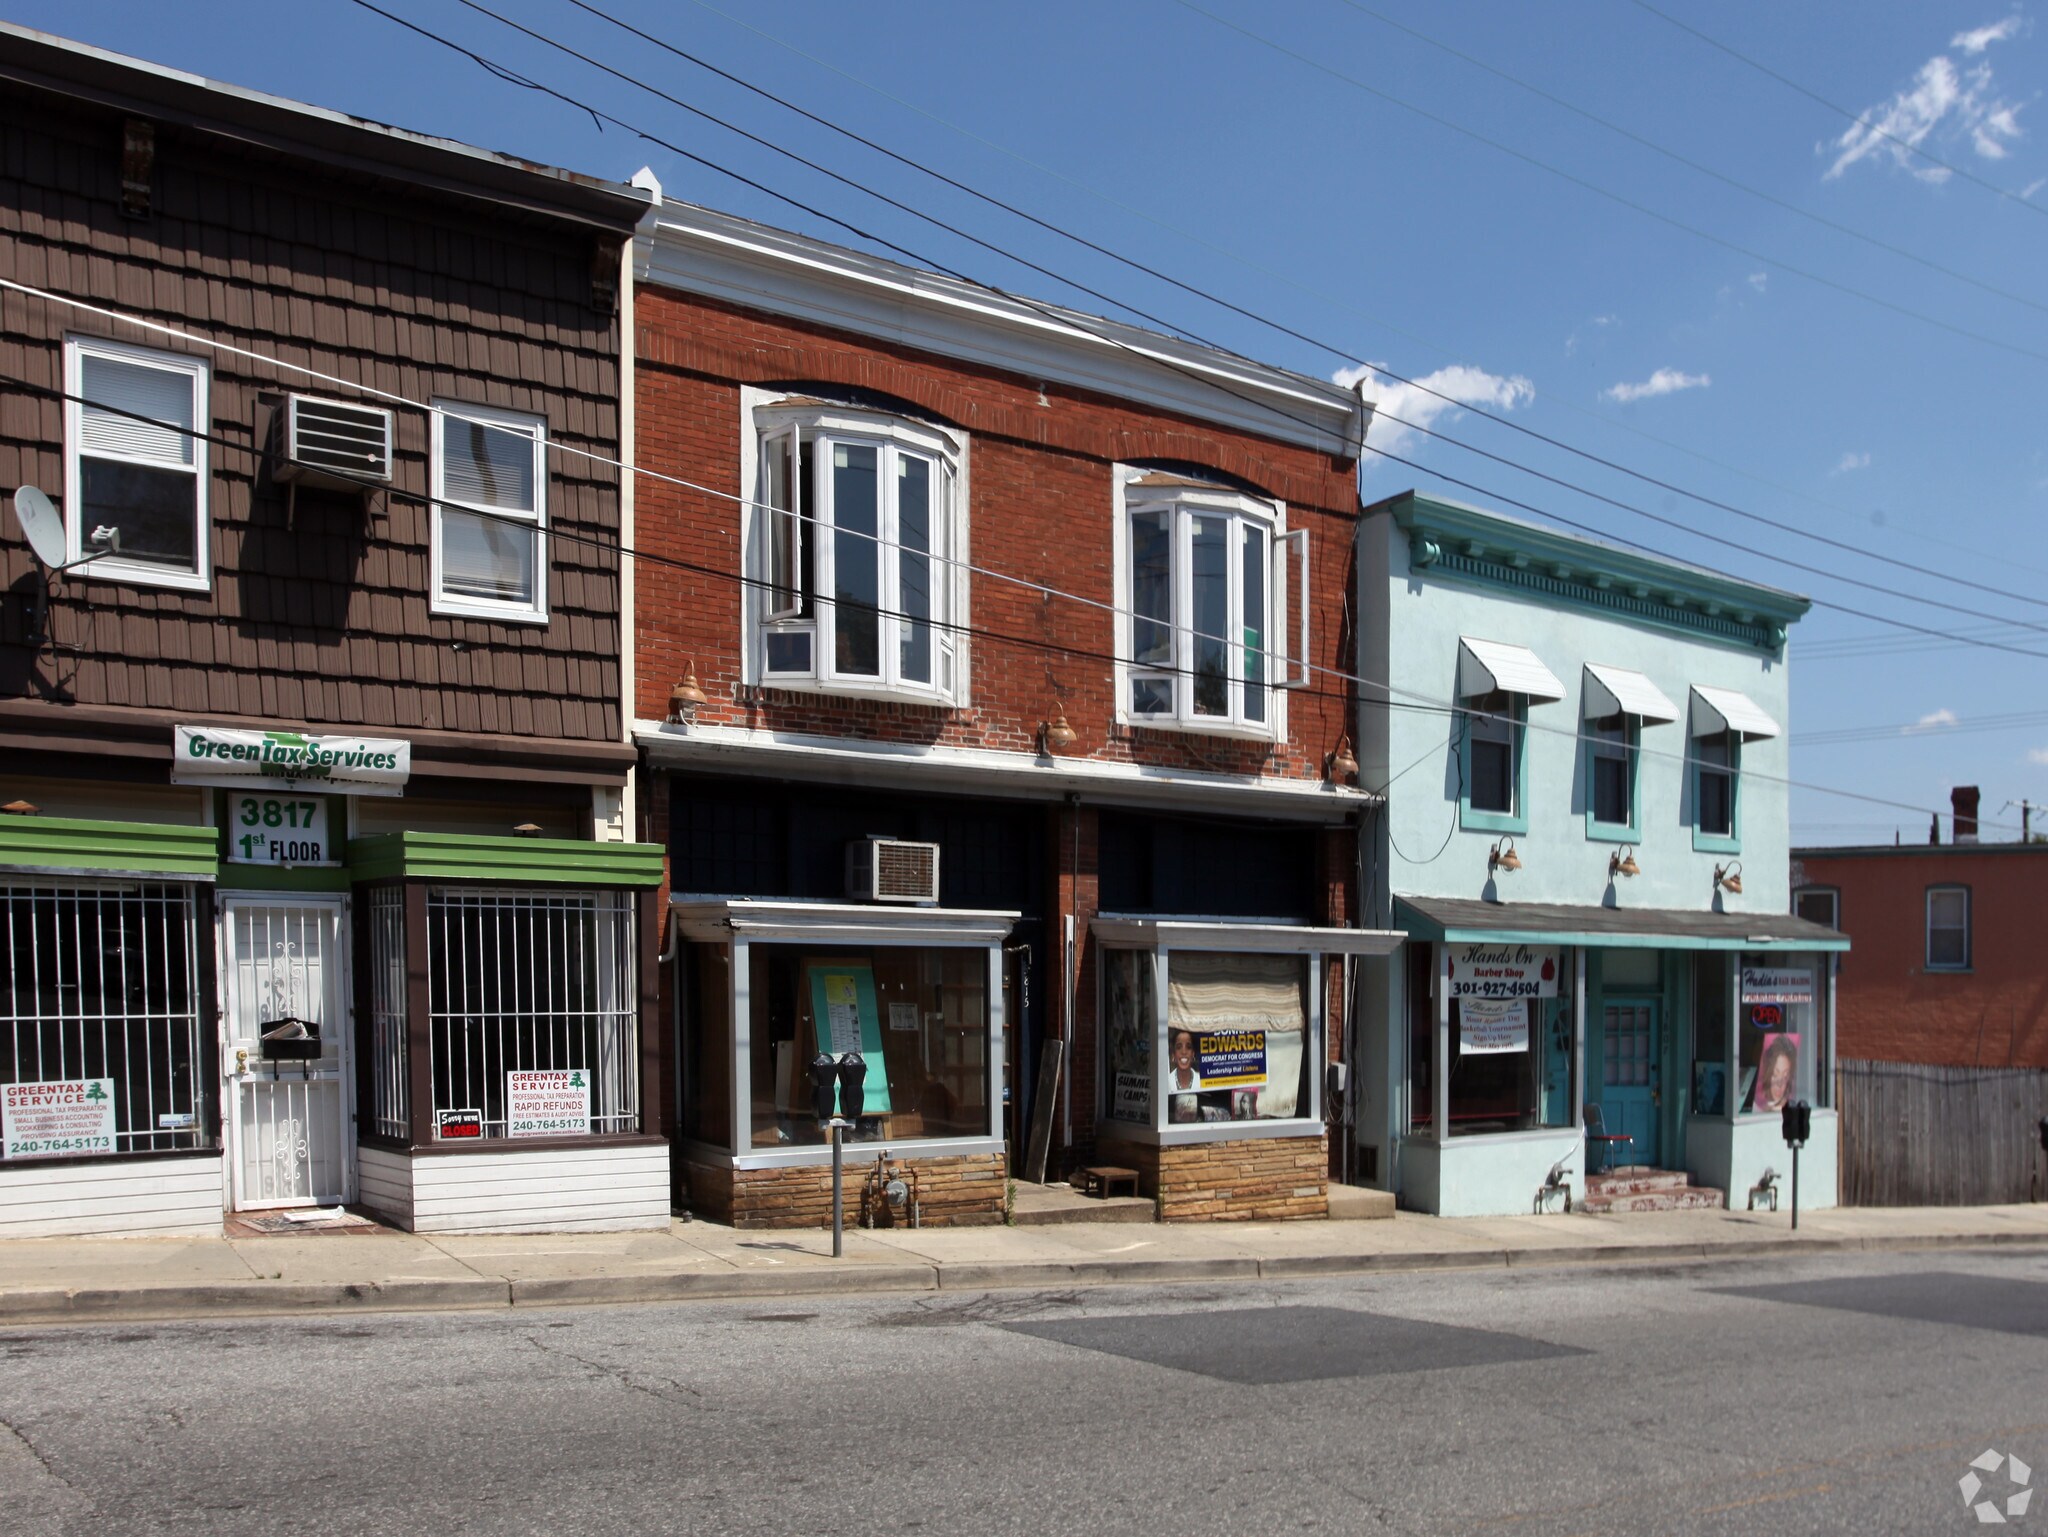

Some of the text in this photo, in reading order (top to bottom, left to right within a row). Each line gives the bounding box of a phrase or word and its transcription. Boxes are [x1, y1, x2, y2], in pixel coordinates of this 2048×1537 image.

[306, 742, 397, 770] Services
[240, 798, 317, 828] 3817
[239, 833, 321, 861] 1st FLOOR
[1462, 943, 1537, 964] Hands On
[1474, 967, 1525, 979] Barber Shop
[1453, 981, 1540, 997] 301-927-4504
[1752, 1004, 1781, 1025] OPEN
[1488, 1023, 1526, 1032] Tournament
[1200, 1033, 1264, 1054] EDWARDS
[1472, 1034, 1487, 1042] Sign
[1201, 1054, 1227, 1063] DEMOCRAT
[1227, 1053, 1237, 1061] FOR
[1238, 1051, 1263, 1060] CONGRESS
[512, 1072, 568, 1081] GREENTAX
[1207, 1066, 1232, 1075] Leadership
[7, 1083, 84, 1096] GREENTAX
[512, 1081, 568, 1090] SERVICE
[8, 1094, 85, 1107] SERVICE
[512, 1092, 545, 1100] PROFESSIONAL
[1123, 1090, 1148, 1103] CAMPS
[9, 1107, 54, 1116] PROFESSIONAL
[67, 1104, 107, 1112] PREPARATION
[514, 1101, 583, 1111] RAPID REFUNDS
[35, 1115, 64, 1123] BUSINESS
[65, 1113, 103, 1121] ACCOUNTING
[441, 1113, 462, 1125] Sorry
[513, 1118, 585, 1130] 240-764-5173
[15, 1123, 58, 1132] BOOKKEEPING
[65, 1121, 102, 1129] CONSULTING
[442, 1124, 479, 1137] CLOSED
[20, 1129, 97, 1140] PROVIDING ASSURANCE
[11, 1136, 110, 1153] 240-764-5173
